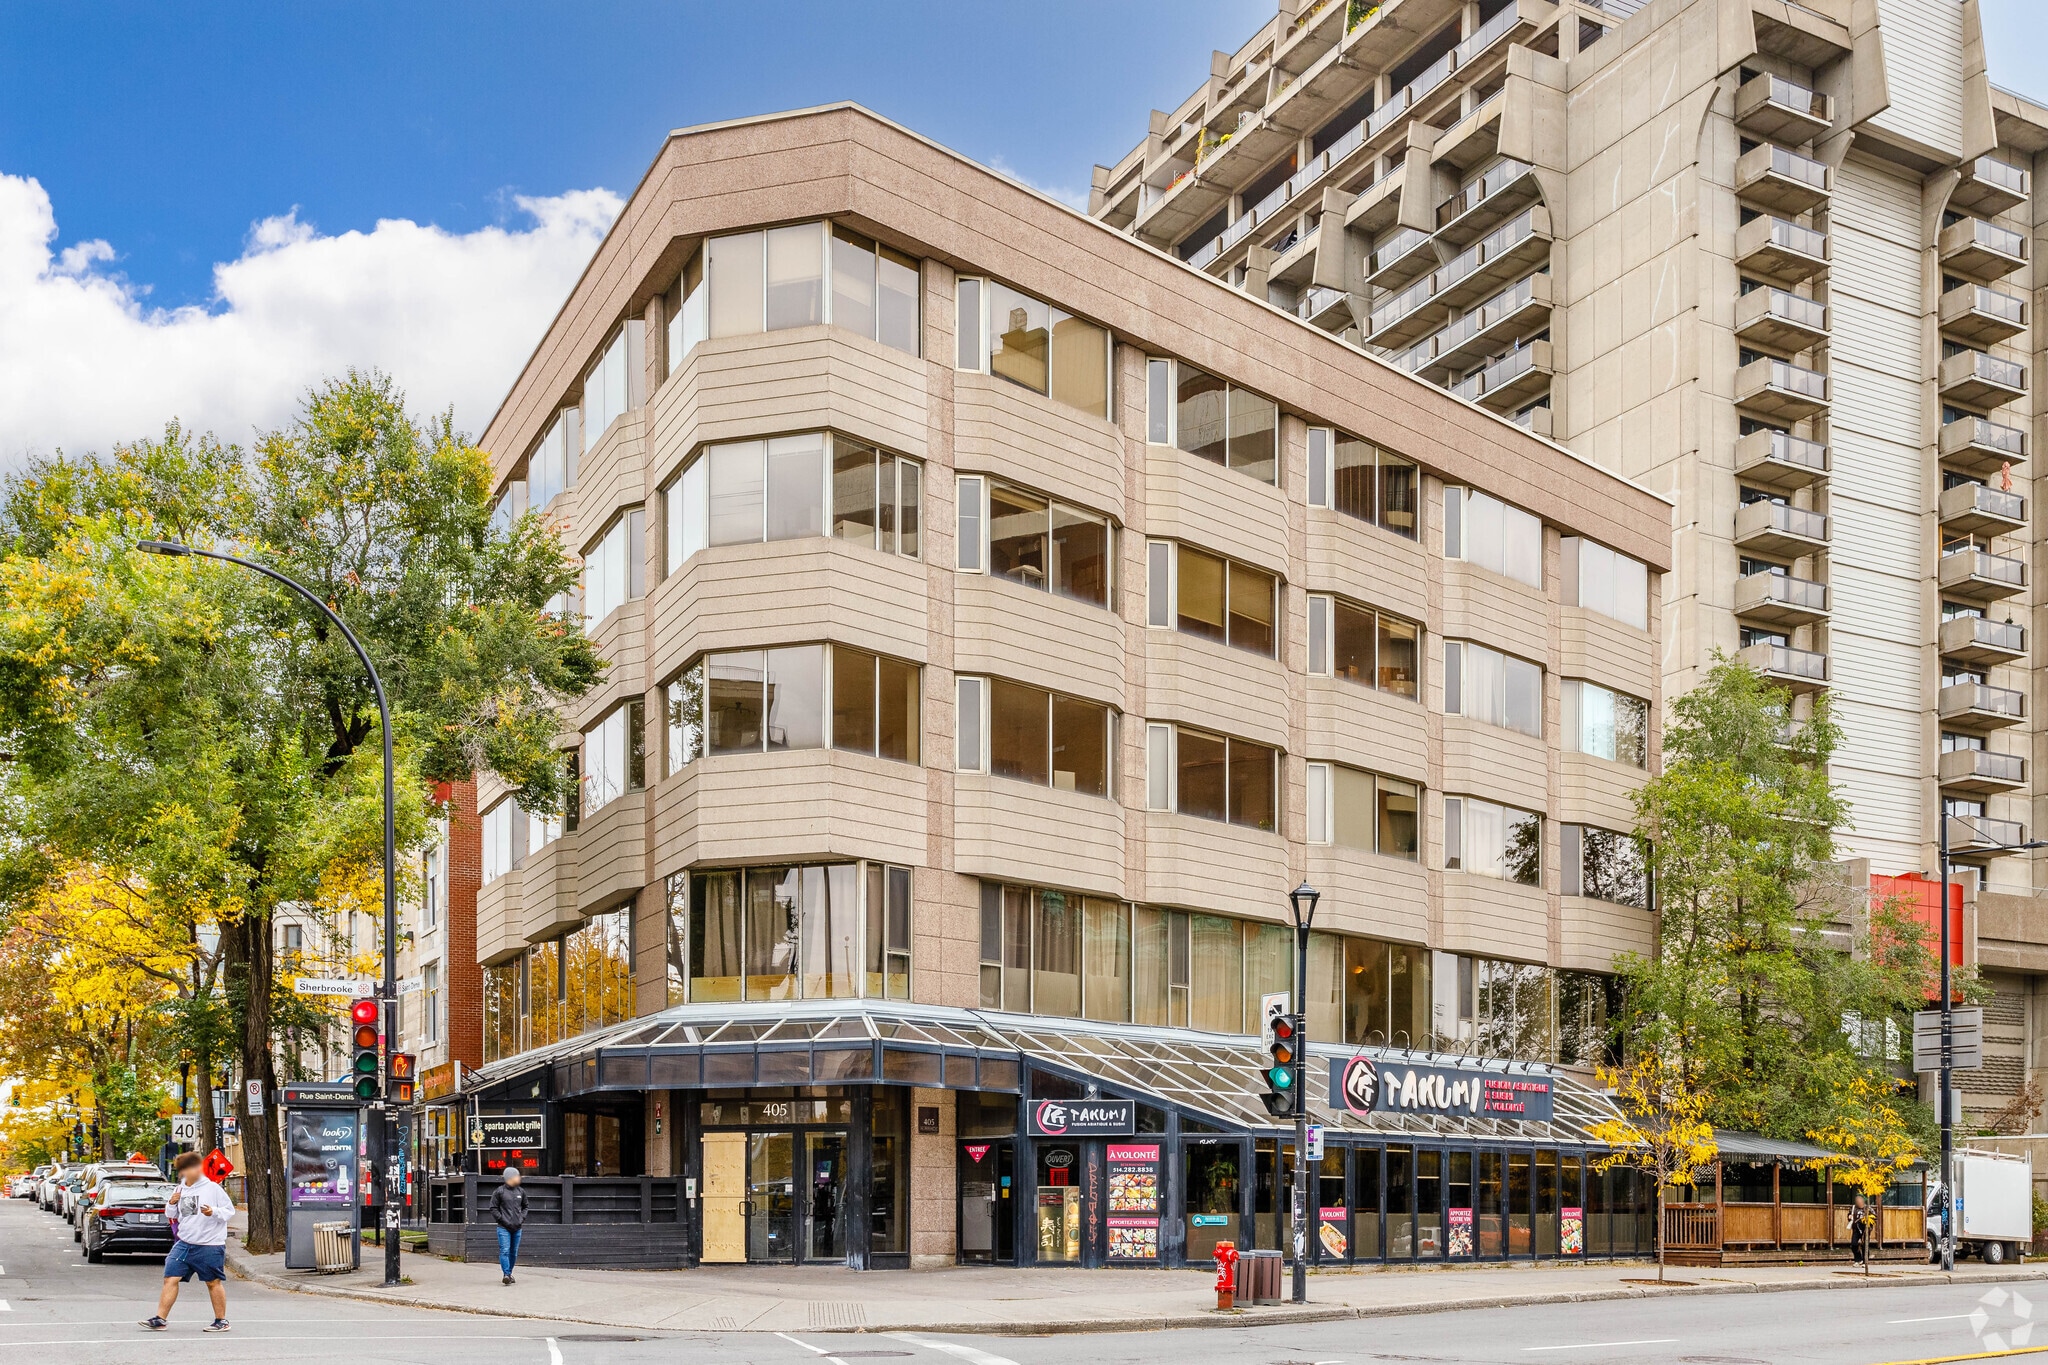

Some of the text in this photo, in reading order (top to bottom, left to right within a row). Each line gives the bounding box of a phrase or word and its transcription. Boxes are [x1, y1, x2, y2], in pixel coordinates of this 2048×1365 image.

[299, 983, 353, 993] Sherbrooke
[1383, 1070, 1480, 1113] TAKUMI
[1484, 1079, 1549, 1093] FUSION ASIATIQUE
[299, 1092, 355, 1100] Rue Saint-Denis
[1484, 1090, 1514, 1101] & SUSHI
[762, 1103, 787, 1117] 405
[1484, 1100, 1525, 1113] À VOLONTÉ
[1070, 1107, 1127, 1121] TAKUMI
[484, 1121, 505, 1132] sparta
[505, 1121, 525, 1132] poulet
[923, 1118, 935, 1126] 405
[174, 1123, 195, 1139] 40
[322, 1126, 353, 1139] looky
[490, 1136, 534, 1144] 514-284-0004
[1047, 1155, 1071, 1163] OUVERT
[1109, 1149, 1157, 1159] À VOLONTÉ
[1325, 1210, 1345, 1218] VOLONTÉ
